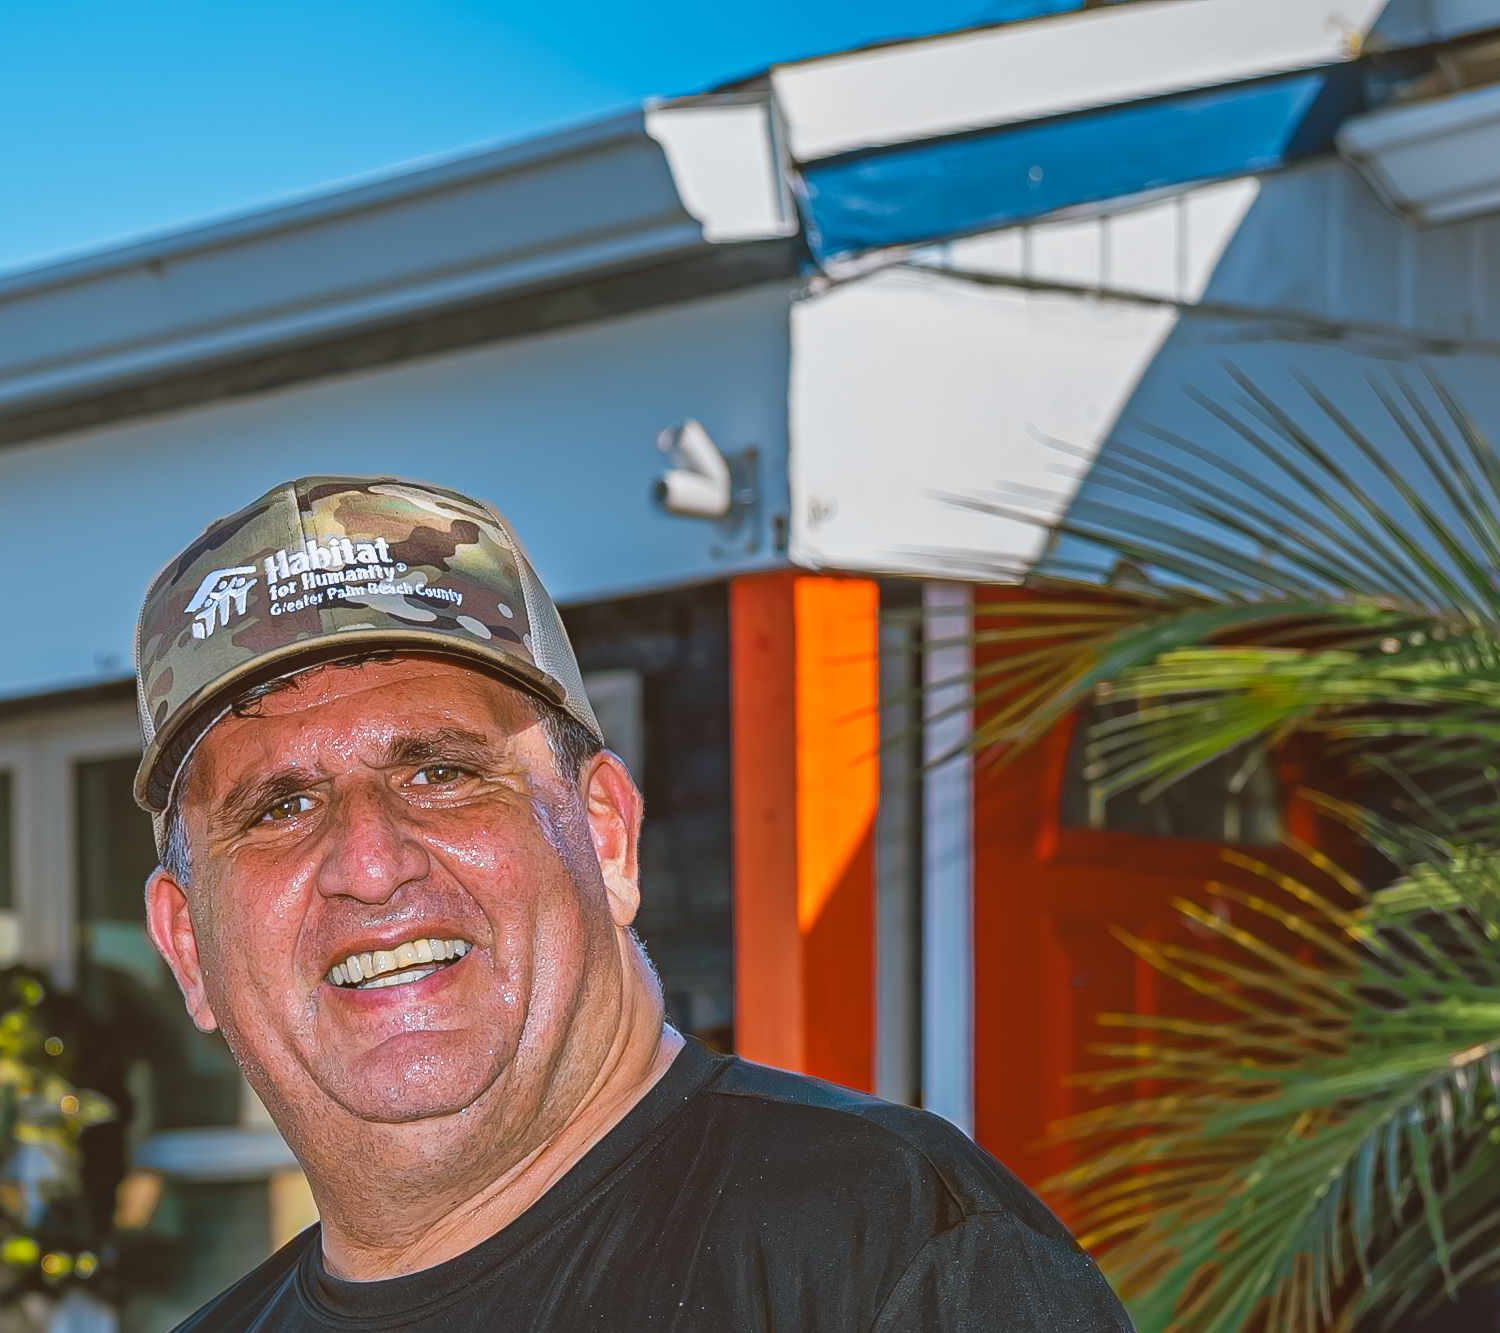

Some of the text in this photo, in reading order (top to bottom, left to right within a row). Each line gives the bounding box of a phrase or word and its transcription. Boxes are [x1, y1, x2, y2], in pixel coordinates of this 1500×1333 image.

[264, 536, 393, 586] Habitat
[269, 581, 298, 601] for
[270, 581, 464, 617] Greater Palm Beach County
